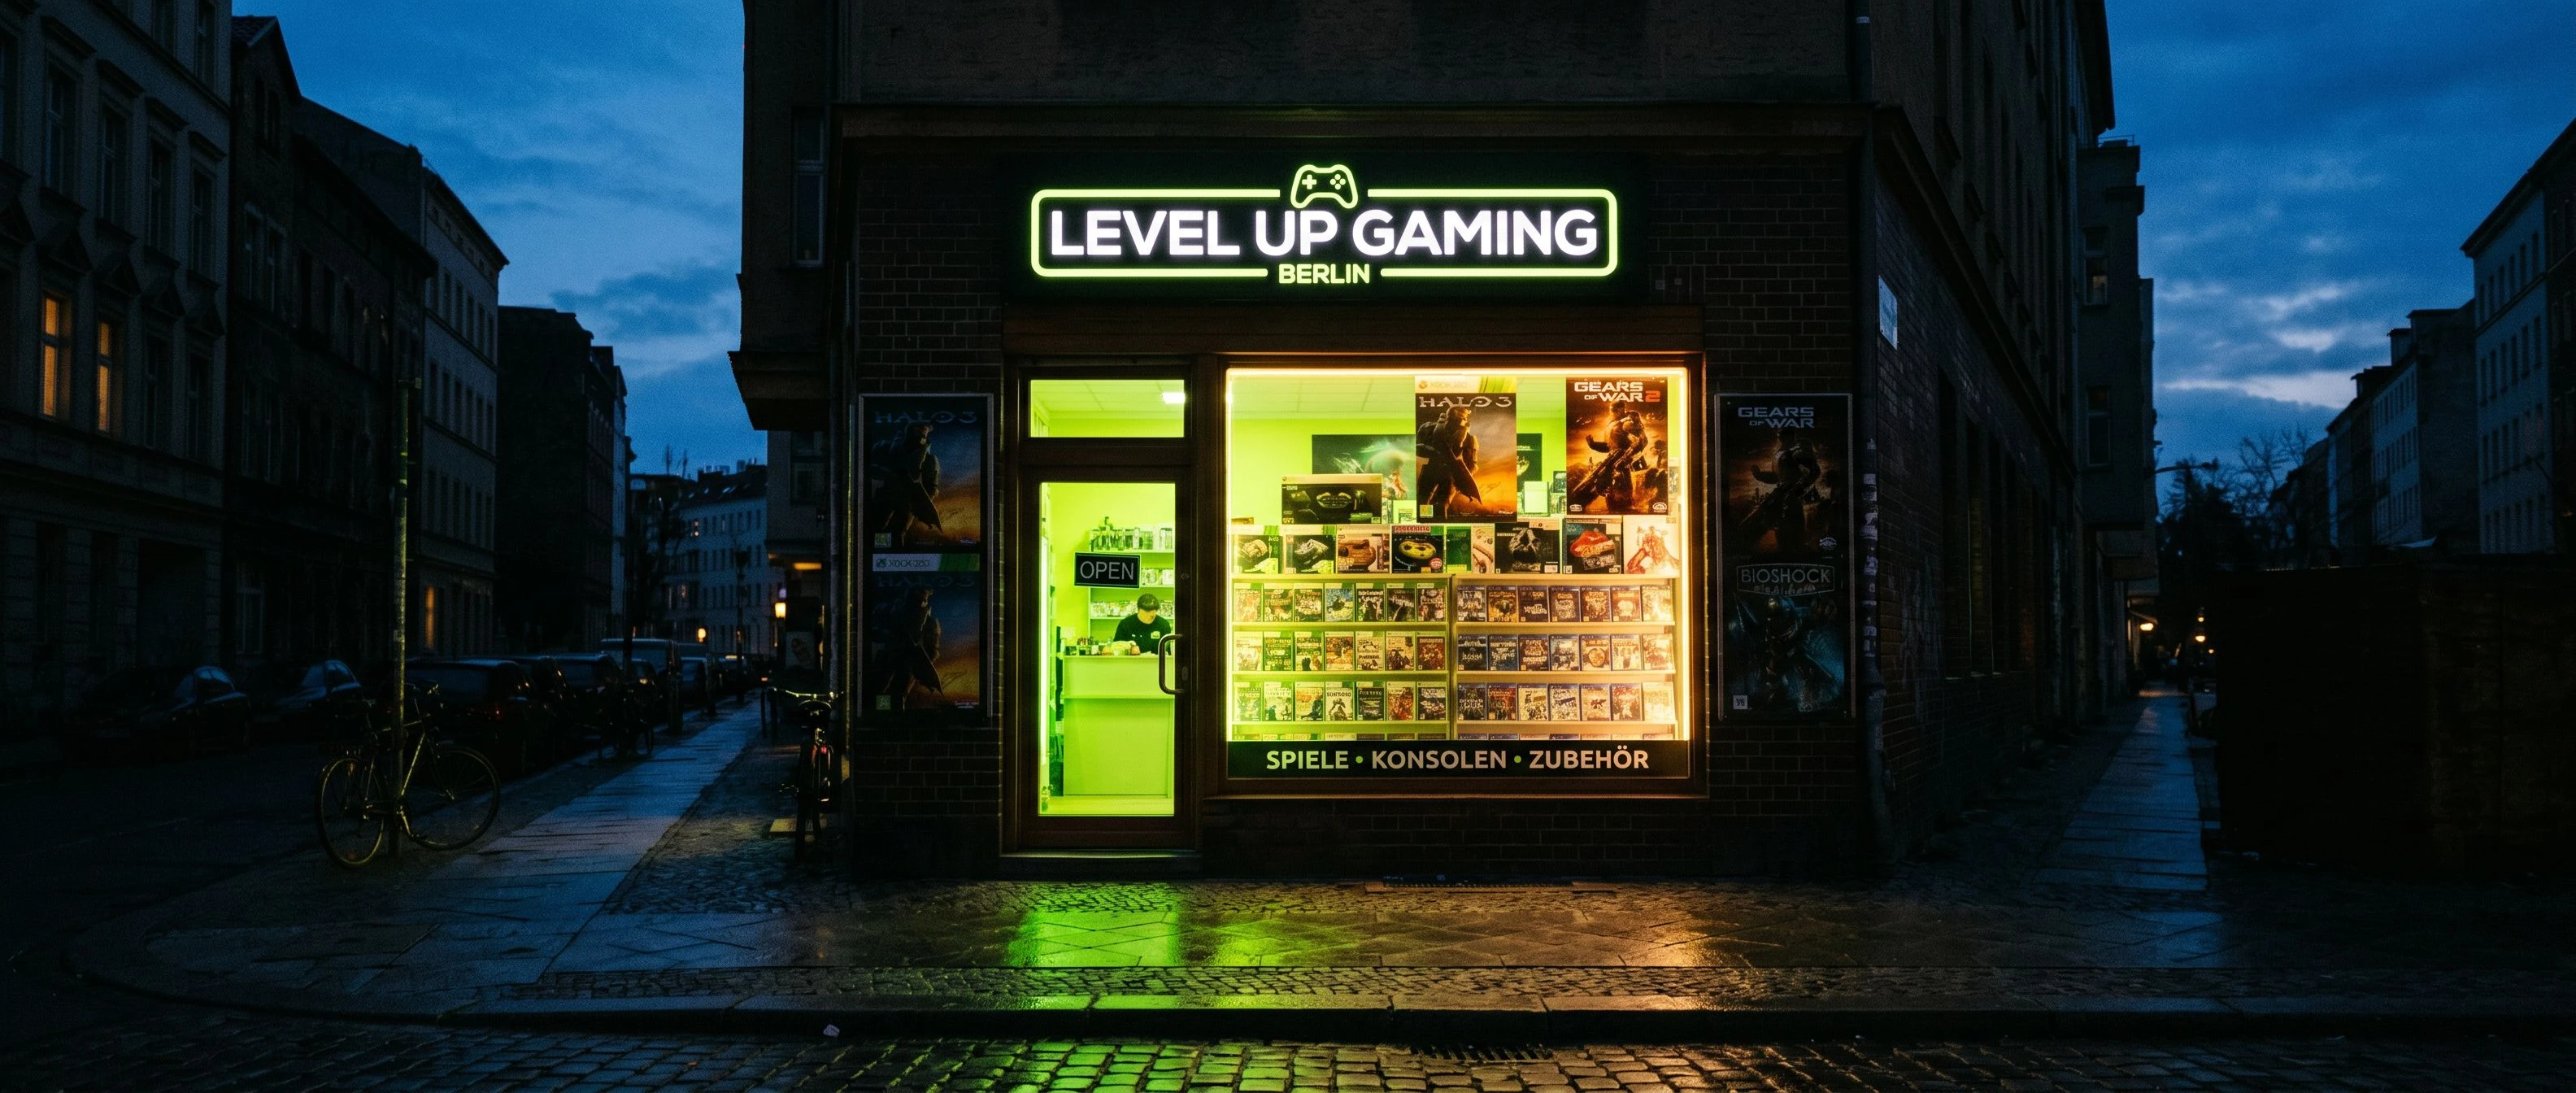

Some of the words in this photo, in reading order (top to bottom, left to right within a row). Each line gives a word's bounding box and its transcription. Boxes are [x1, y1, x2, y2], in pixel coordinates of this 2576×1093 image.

[1051, 210, 1240, 255] LEVEL
[1255, 210, 1338, 256] UP
[1351, 210, 1597, 256] GAMING
[1278, 263, 1370, 284] BERLIN
[1574, 381, 1643, 392] GEARS
[1419, 395, 1493, 407] HALO
[1495, 396, 1512, 407] 3
[1599, 392, 1644, 403] WAR
[1645, 390, 1661, 403] 2
[873, 411, 956, 424] HALO
[1737, 407, 1815, 418] GEARS
[1765, 417, 1815, 429] WAR
[1080, 560, 1134, 580] OPEN
[1741, 568, 1830, 583] BIOSHOCK
[1266, 750, 1349, 769] SPIELE
[1372, 750, 1507, 769] KONSOLEN
[1529, 745, 1650, 769] ZUBEHÖR
